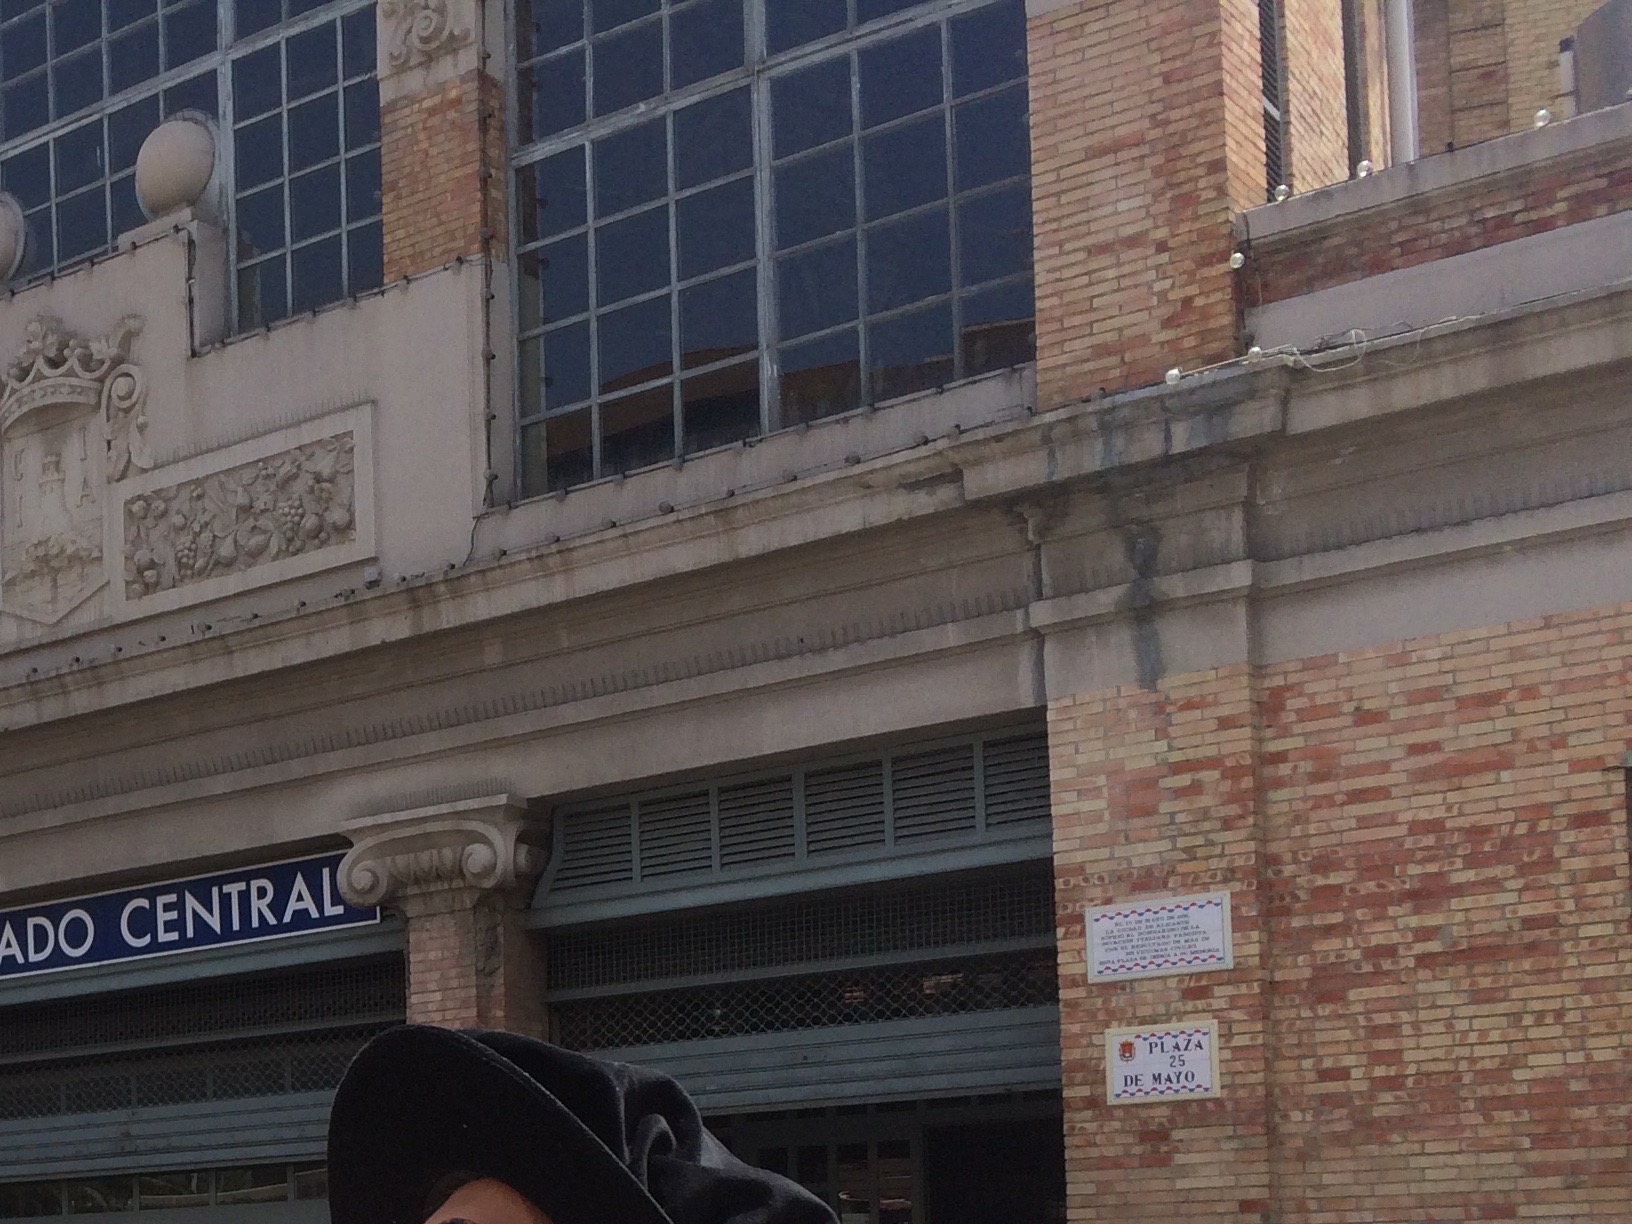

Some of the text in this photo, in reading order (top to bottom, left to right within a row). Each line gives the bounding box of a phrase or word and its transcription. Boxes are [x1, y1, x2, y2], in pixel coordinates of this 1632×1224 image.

[119, 866, 345, 949] CENTRAL
[1148, 1038, 1204, 1054] PLAZA
[1169, 1054, 1186, 1068] 25
[1123, 1070, 1195, 1087] DE MAYO
